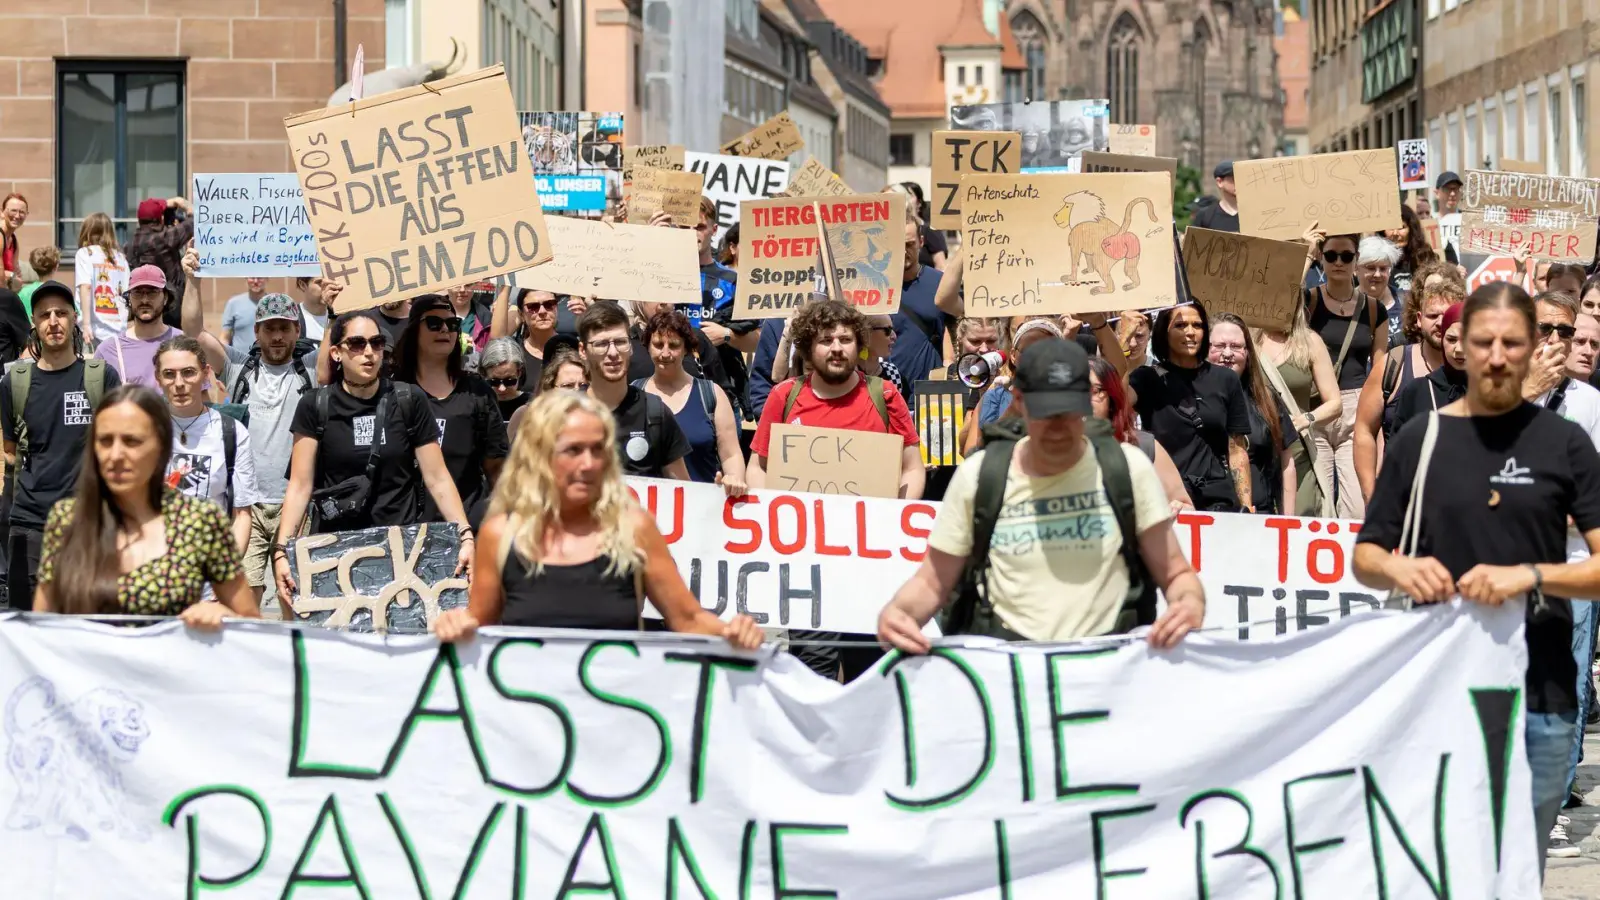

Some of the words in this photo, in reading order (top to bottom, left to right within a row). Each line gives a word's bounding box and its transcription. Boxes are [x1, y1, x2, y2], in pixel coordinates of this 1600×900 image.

[340, 105, 473, 175] LASST
[636, 146, 667, 158] MORD
[945, 138, 1013, 174] FCK
[259, 177, 303, 199] FISCHO
[345, 170, 408, 215] DIE
[417, 140, 518, 199] AFFEN
[554, 178, 602, 192] UNSER
[540, 193, 569, 207] NIS!
[967, 184, 1040, 201] Artenschutz
[1466, 171, 1599, 218] OVERPOPULATION
[252, 205, 311, 226] PAVIAN
[400, 193, 465, 241] AUS
[752, 200, 890, 228] TIERGARTEN
[967, 209, 1004, 225] durch
[1484, 205, 1508, 223] DOES
[1510, 208, 1530, 224] NOT
[1535, 208, 1580, 230] JUSTIFY
[198, 227, 224, 245] Was
[229, 230, 258, 244] wird
[279, 227, 314, 247] Bayer
[968, 228, 1010, 247] Töten
[1442, 224, 1461, 236] TIE
[1469, 228, 1579, 257] MURDER
[200, 252, 216, 266] als
[275, 249, 320, 268] abgeknal
[319, 221, 359, 286] FCK
[969, 253, 988, 271] ist
[1186, 233, 1249, 281] MORD
[1252, 252, 1271, 285] ist
[749, 265, 816, 286] Stoppt
[837, 267, 858, 280] en
[847, 289, 882, 306] ORD
[972, 278, 1043, 308] Arsch!
[782, 434, 858, 465] FCK
[723, 494, 937, 562] SOLLS
[690, 558, 821, 628] UCH
[288, 628, 760, 806] LASST
[881, 647, 1142, 812] DIE
